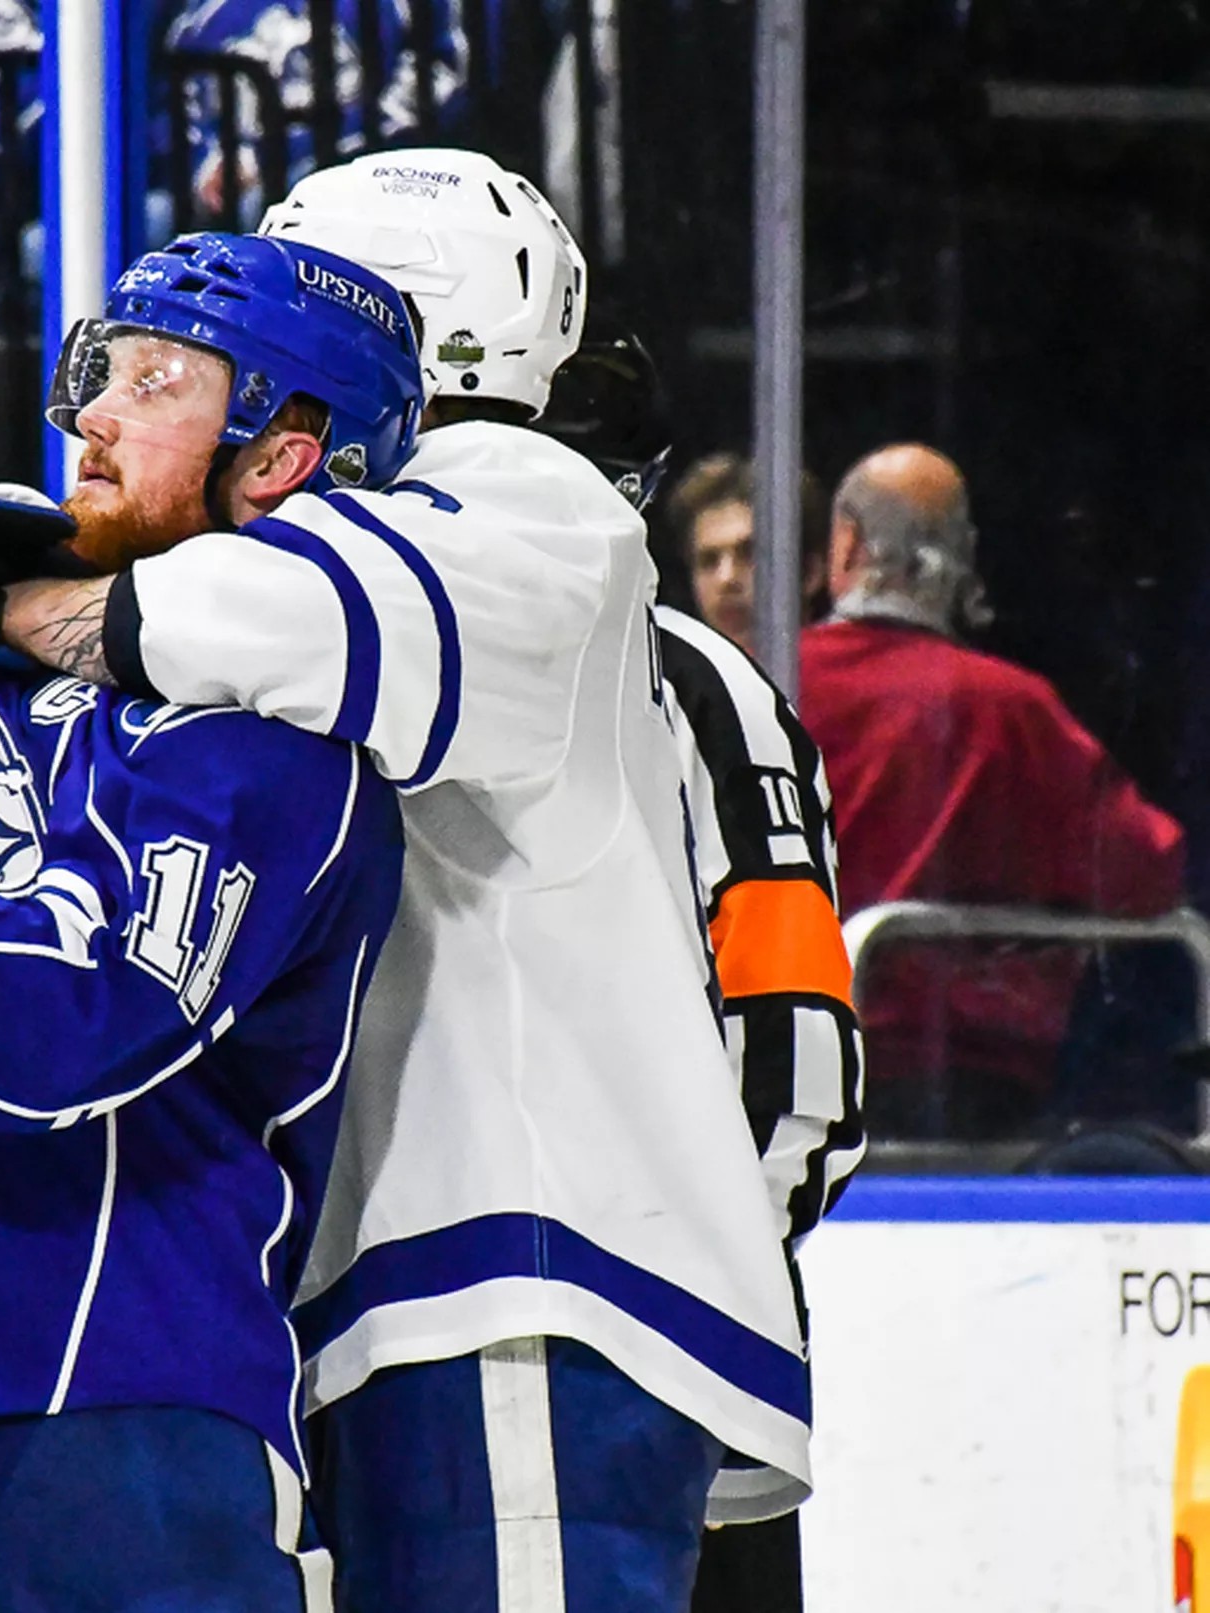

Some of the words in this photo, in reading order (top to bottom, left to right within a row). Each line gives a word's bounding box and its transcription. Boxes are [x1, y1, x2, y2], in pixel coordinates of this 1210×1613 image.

[297, 259, 397, 335] UPSTATE
[758, 774, 806, 832] 10
[124, 834, 257, 1026] 11
